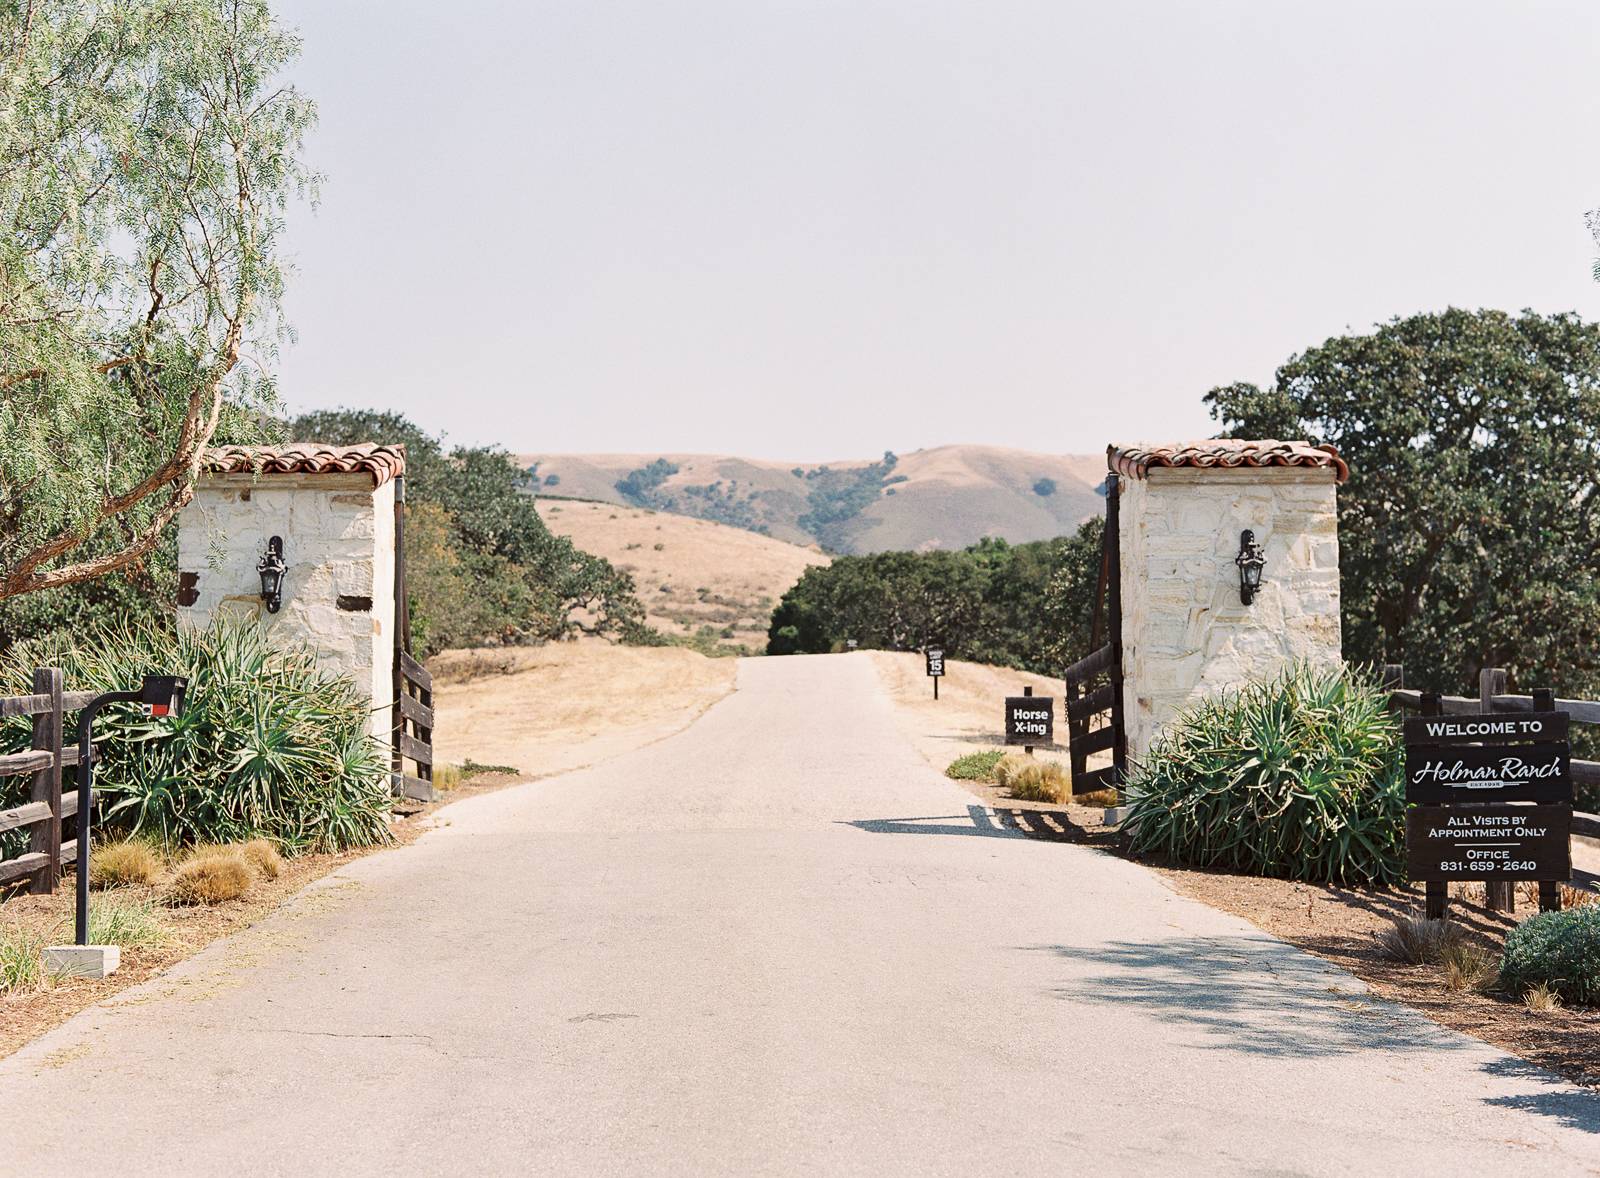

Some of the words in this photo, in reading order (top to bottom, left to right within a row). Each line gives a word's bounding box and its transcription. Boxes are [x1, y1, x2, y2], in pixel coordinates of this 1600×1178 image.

[929, 660, 942, 670] 15
[1013, 709, 1048, 719] Horse
[1015, 721, 1047, 735] X-ing
[1426, 722, 1516, 736] WELCOME
[1519, 720, 1542, 732] TO
[1412, 760, 1498, 784] Holman
[1499, 757, 1561, 778] Ranch
[1447, 816, 1471, 826] ALL
[1473, 816, 1510, 825] VISITS
[1512, 816, 1527, 825] BY
[1428, 828, 1513, 838] APPOINTMENT
[1515, 827, 1547, 837] ONLY
[1466, 850, 1510, 859] OFFICE
